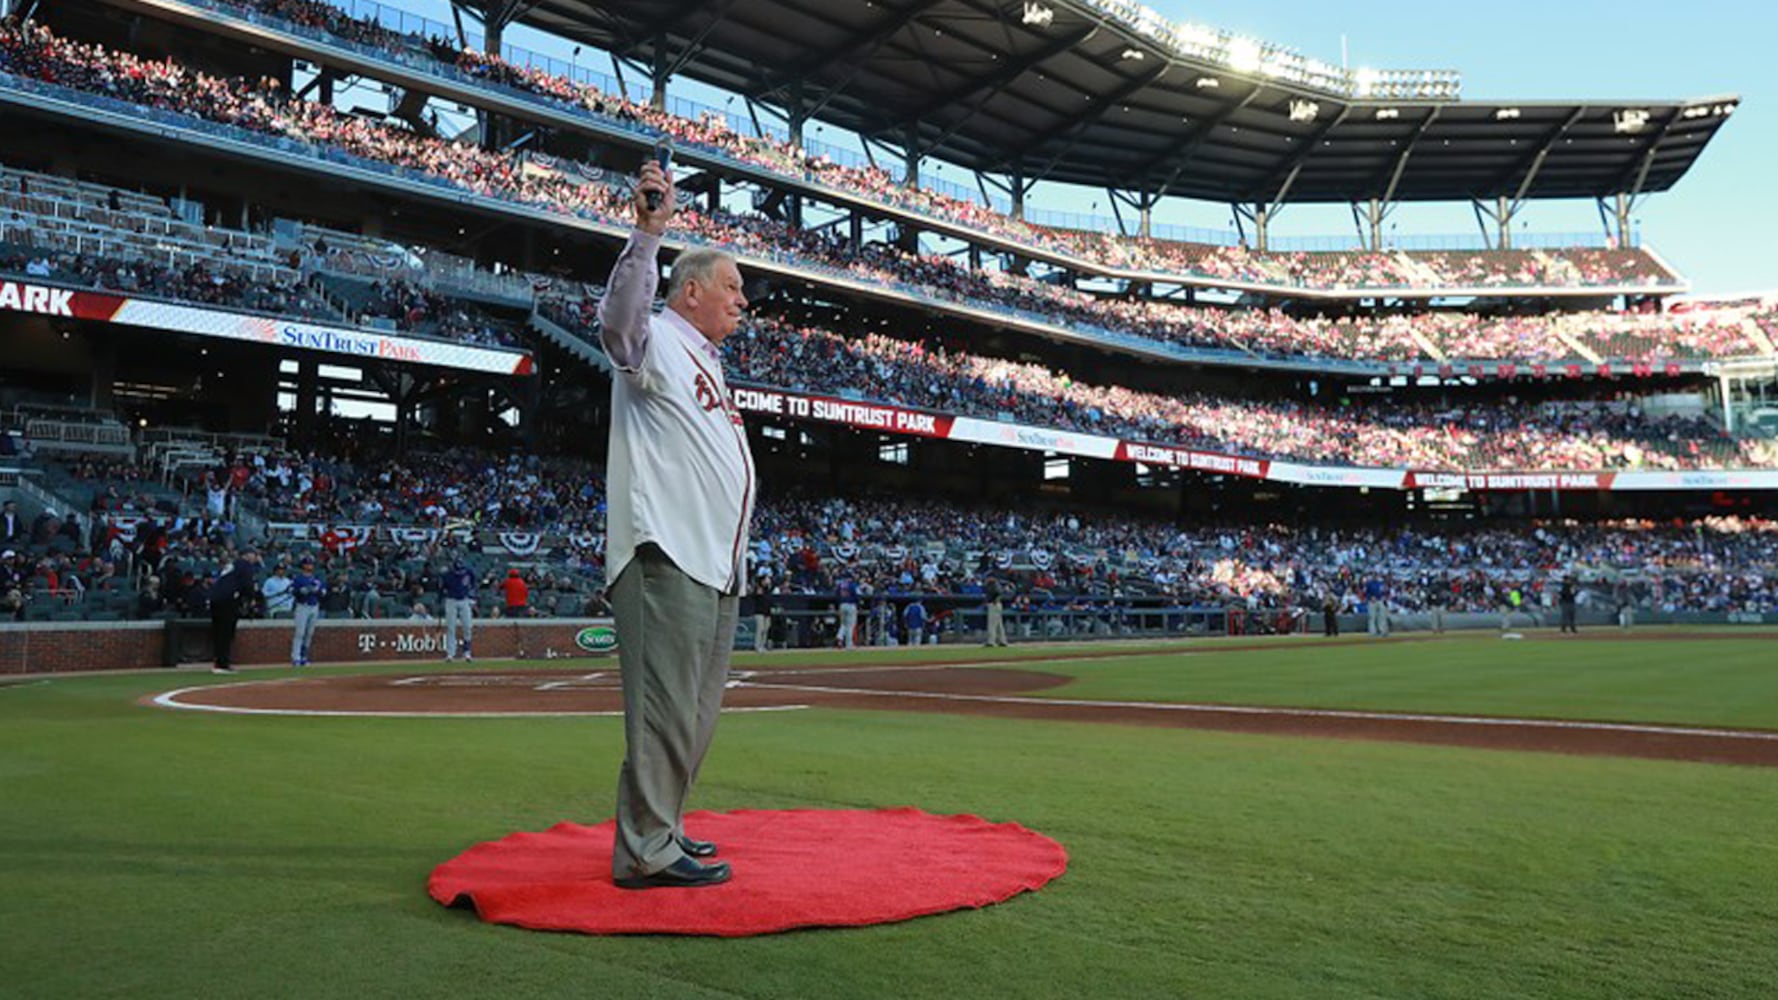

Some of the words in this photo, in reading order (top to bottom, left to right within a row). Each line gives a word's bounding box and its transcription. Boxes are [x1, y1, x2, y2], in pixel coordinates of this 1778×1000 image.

[0, 282, 74, 317] ARK
[786, 396, 809, 416] TO
[812, 400, 893, 427] SUNTRUST
[897, 411, 935, 433] PARK
[1126, 443, 1175, 463] WELCOME
[1176, 451, 1189, 465] TO
[1414, 473, 1467, 488] WELCOME
[1468, 474, 1485, 488] TO
[1560, 473, 1598, 488] PARK
